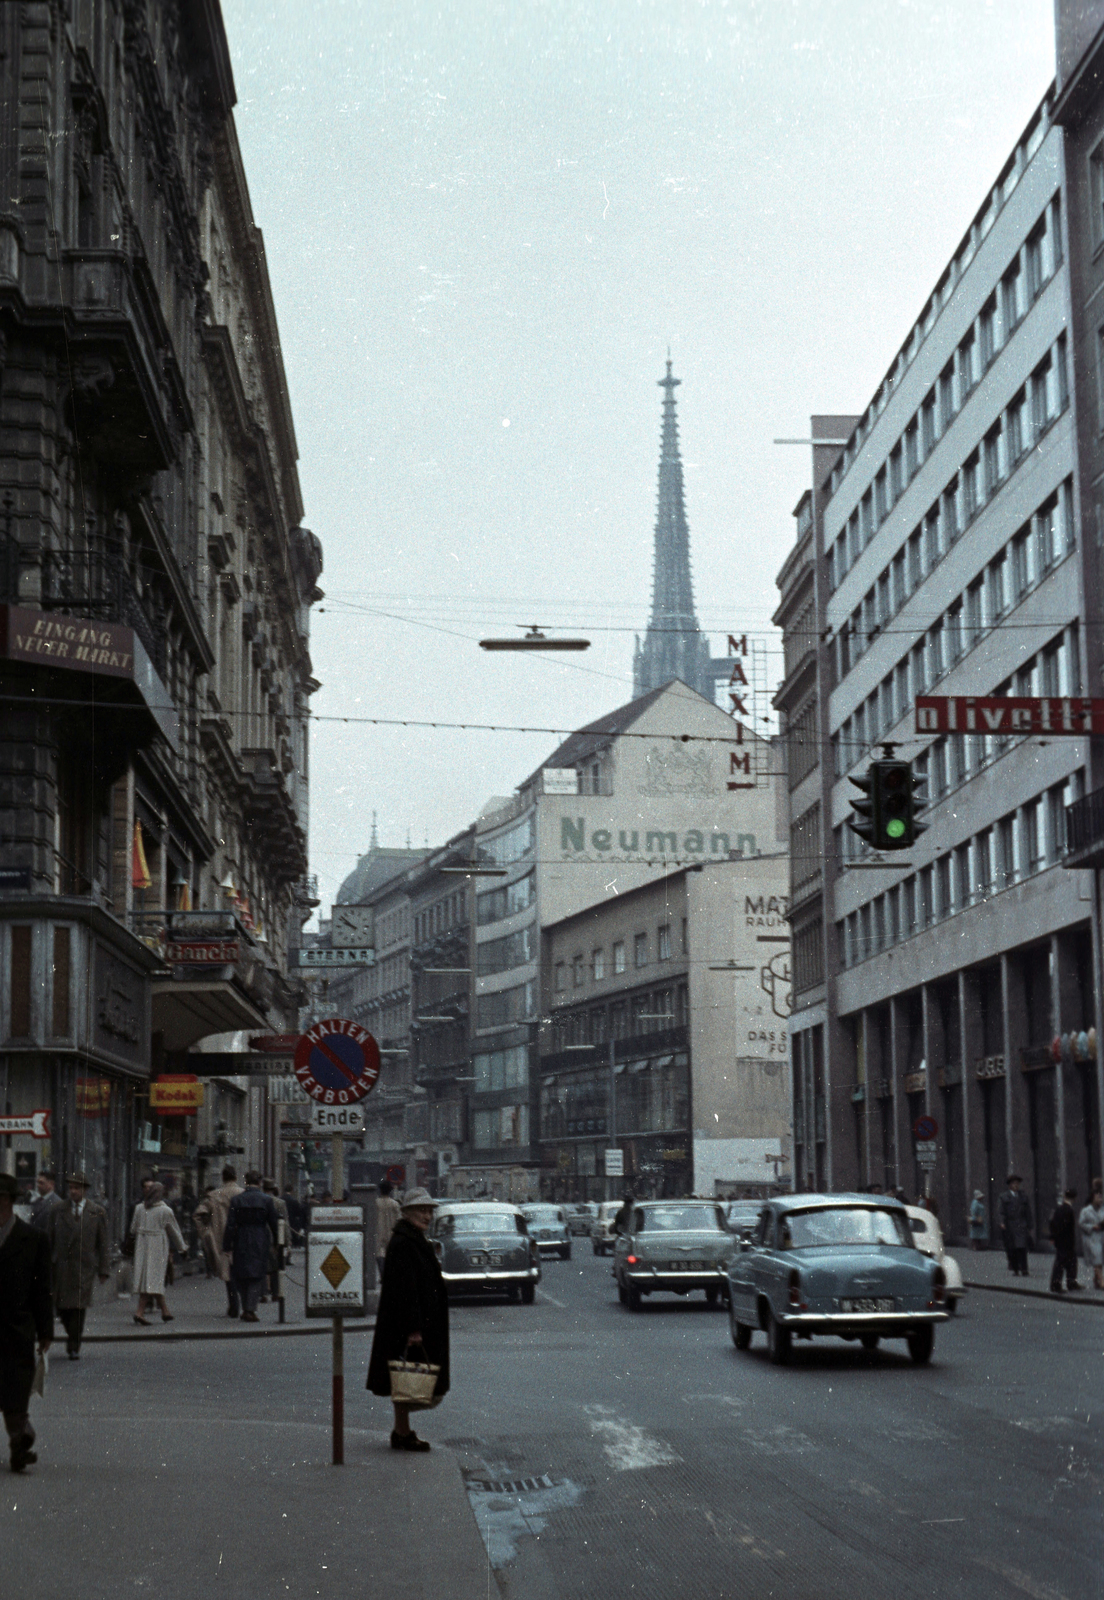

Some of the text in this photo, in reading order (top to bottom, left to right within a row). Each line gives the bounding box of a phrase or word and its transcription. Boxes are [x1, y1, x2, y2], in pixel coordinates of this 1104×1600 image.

[34, 619, 111, 647] EINGANG
[14, 634, 132, 668] NEUER MARKT
[727, 634, 751, 775] MAXIM
[917, 698, 1093, 731] olivetti
[560, 816, 757, 854] Neumann
[167, 942, 237, 961] Gancia
[306, 1021, 370, 1044] HALTEN
[748, 1031, 776, 1042] DAS
[155, 1089, 196, 1101] Kodak
[296, 1065, 378, 1104] VERBOTEN
[317, 1109, 358, 1126] Ende
